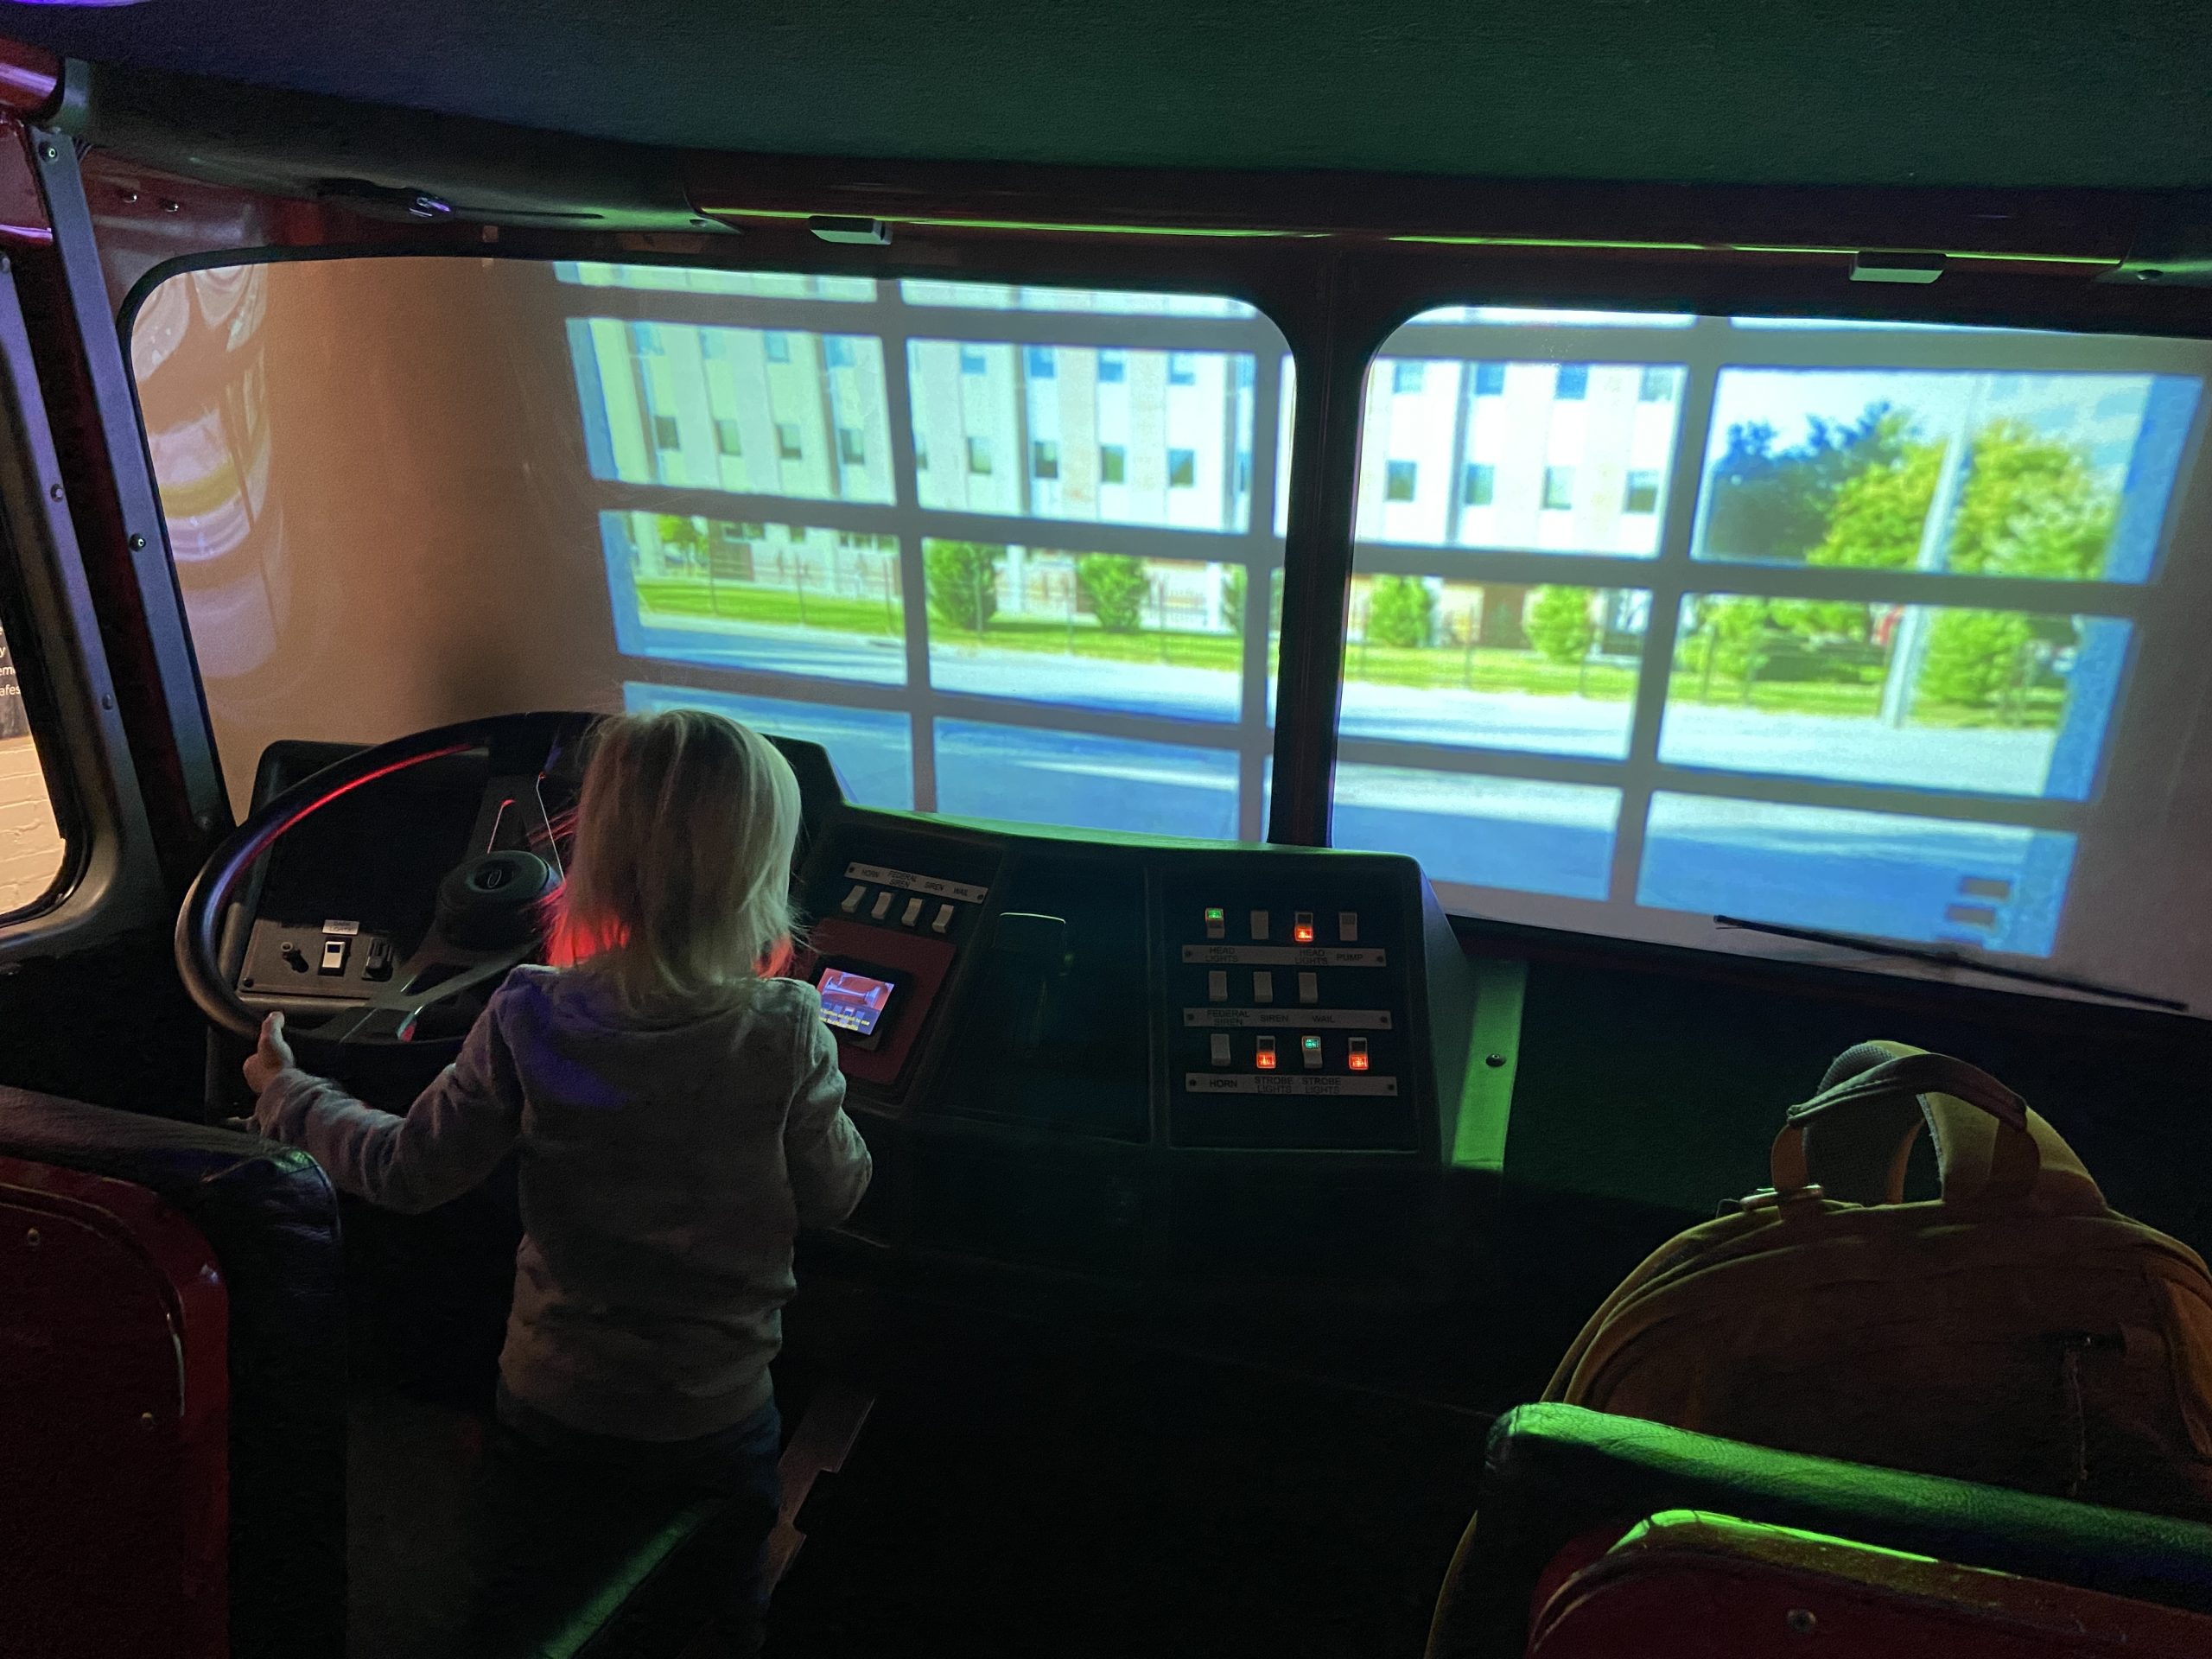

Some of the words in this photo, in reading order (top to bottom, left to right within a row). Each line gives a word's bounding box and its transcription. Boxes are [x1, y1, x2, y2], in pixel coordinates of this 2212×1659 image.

[861, 869, 879, 878] HORN
[887, 870, 916, 882] FEDERAL
[889, 879, 910, 888] SIREN
[925, 881, 944, 891] SIREN
[1207, 1009, 1250, 1018] FEDERAL
[1210, 1079, 1237, 1088] HORN
[1255, 1076, 1294, 1084] STROBE
